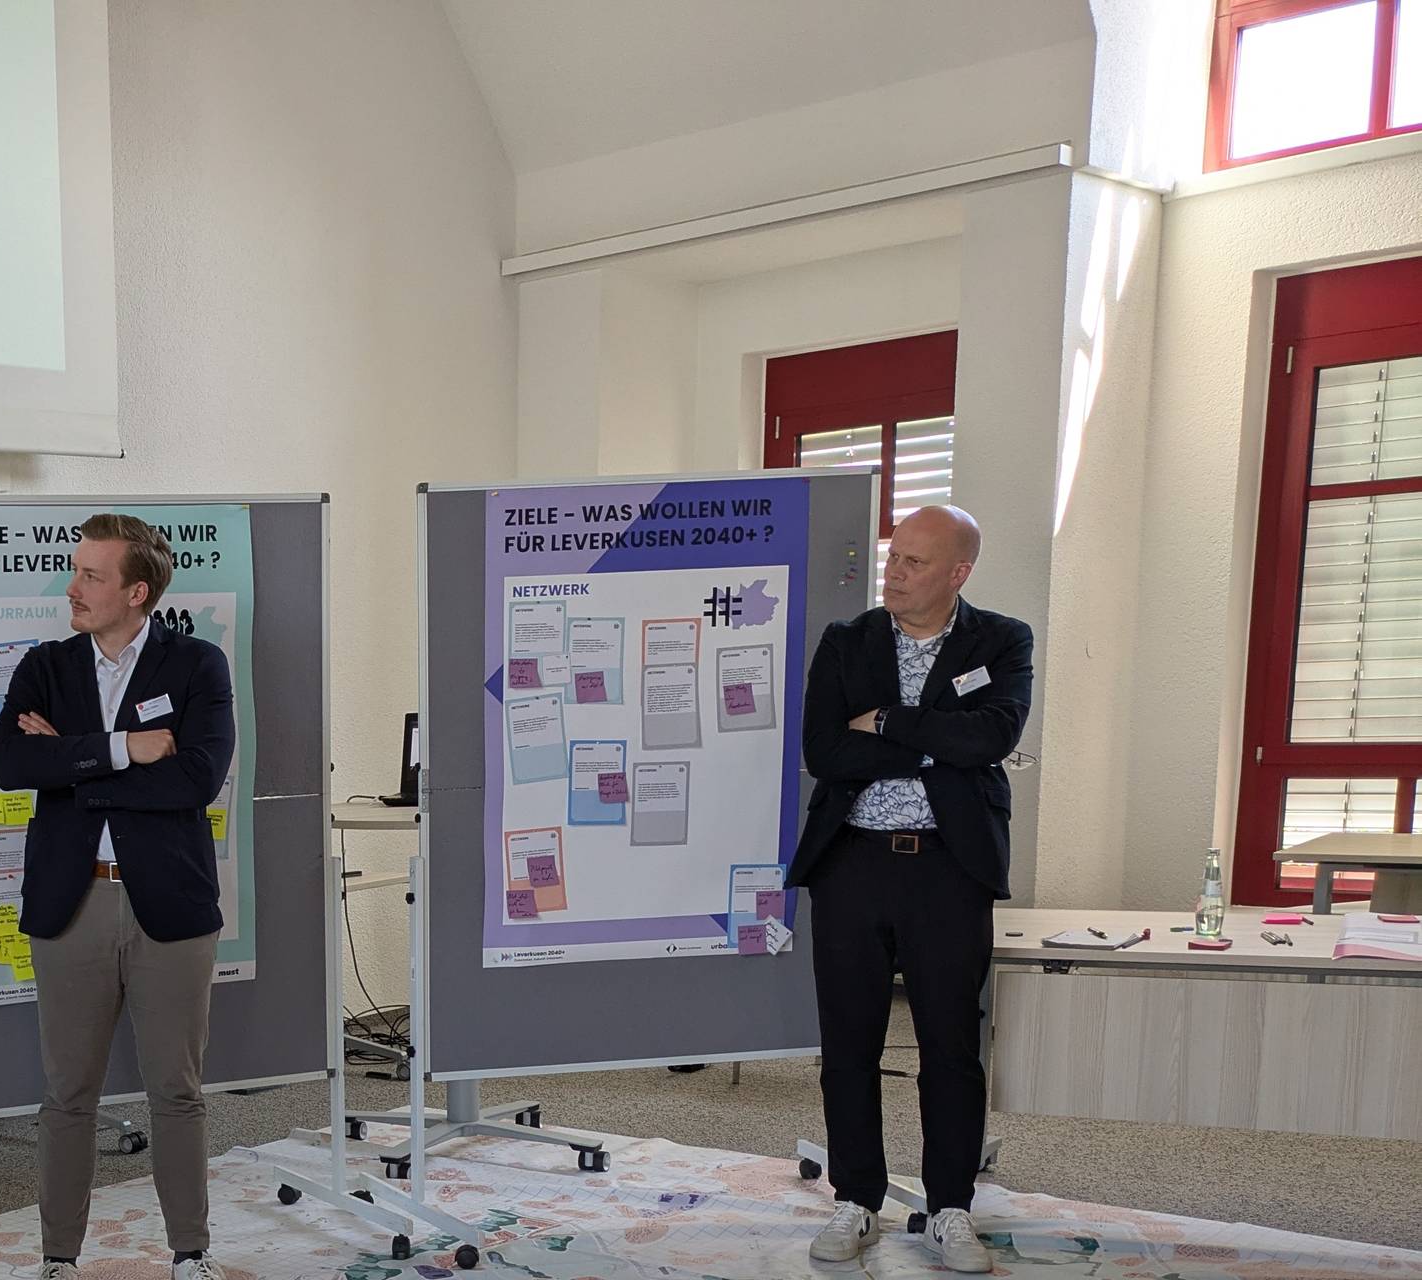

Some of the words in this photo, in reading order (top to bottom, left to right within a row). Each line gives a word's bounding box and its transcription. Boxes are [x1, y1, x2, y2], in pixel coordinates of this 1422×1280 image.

[504, 507, 558, 526] ZIELE
[582, 504, 633, 523] WAS
[638, 501, 726, 521] WOLLEN
[731, 499, 772, 517] WIR
[32, 525, 82, 544] WAS
[178, 525, 218, 542] WIR
[504, 531, 545, 554] FÜR
[550, 528, 685, 552] LEVERKUSEN
[691, 526, 758, 546] 2040+
[763, 525, 774, 543] ?
[210, 552, 221, 569] ?
[512, 583, 590, 598] NETZWERK
[218, 968, 240, 977] must
